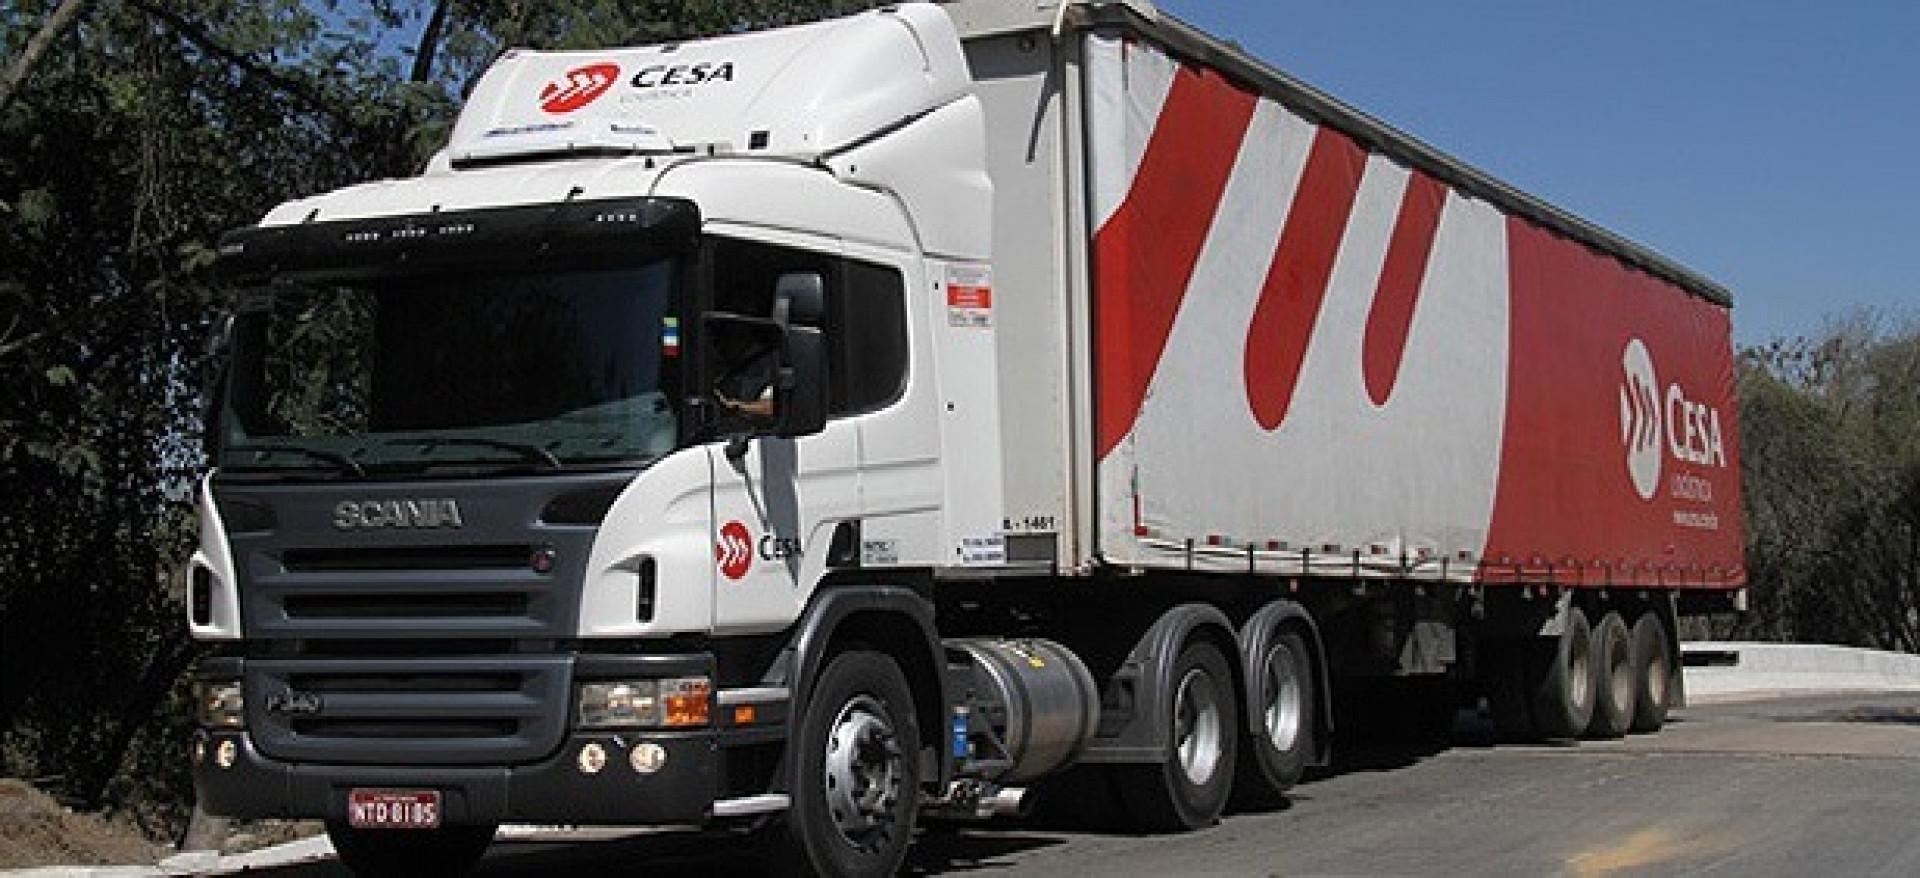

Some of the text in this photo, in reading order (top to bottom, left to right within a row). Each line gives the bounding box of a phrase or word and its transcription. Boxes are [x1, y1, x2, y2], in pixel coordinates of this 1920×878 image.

[631, 62, 734, 88] CESA
[1666, 382, 1727, 467] CESA
[333, 498, 463, 528] SCANIA
